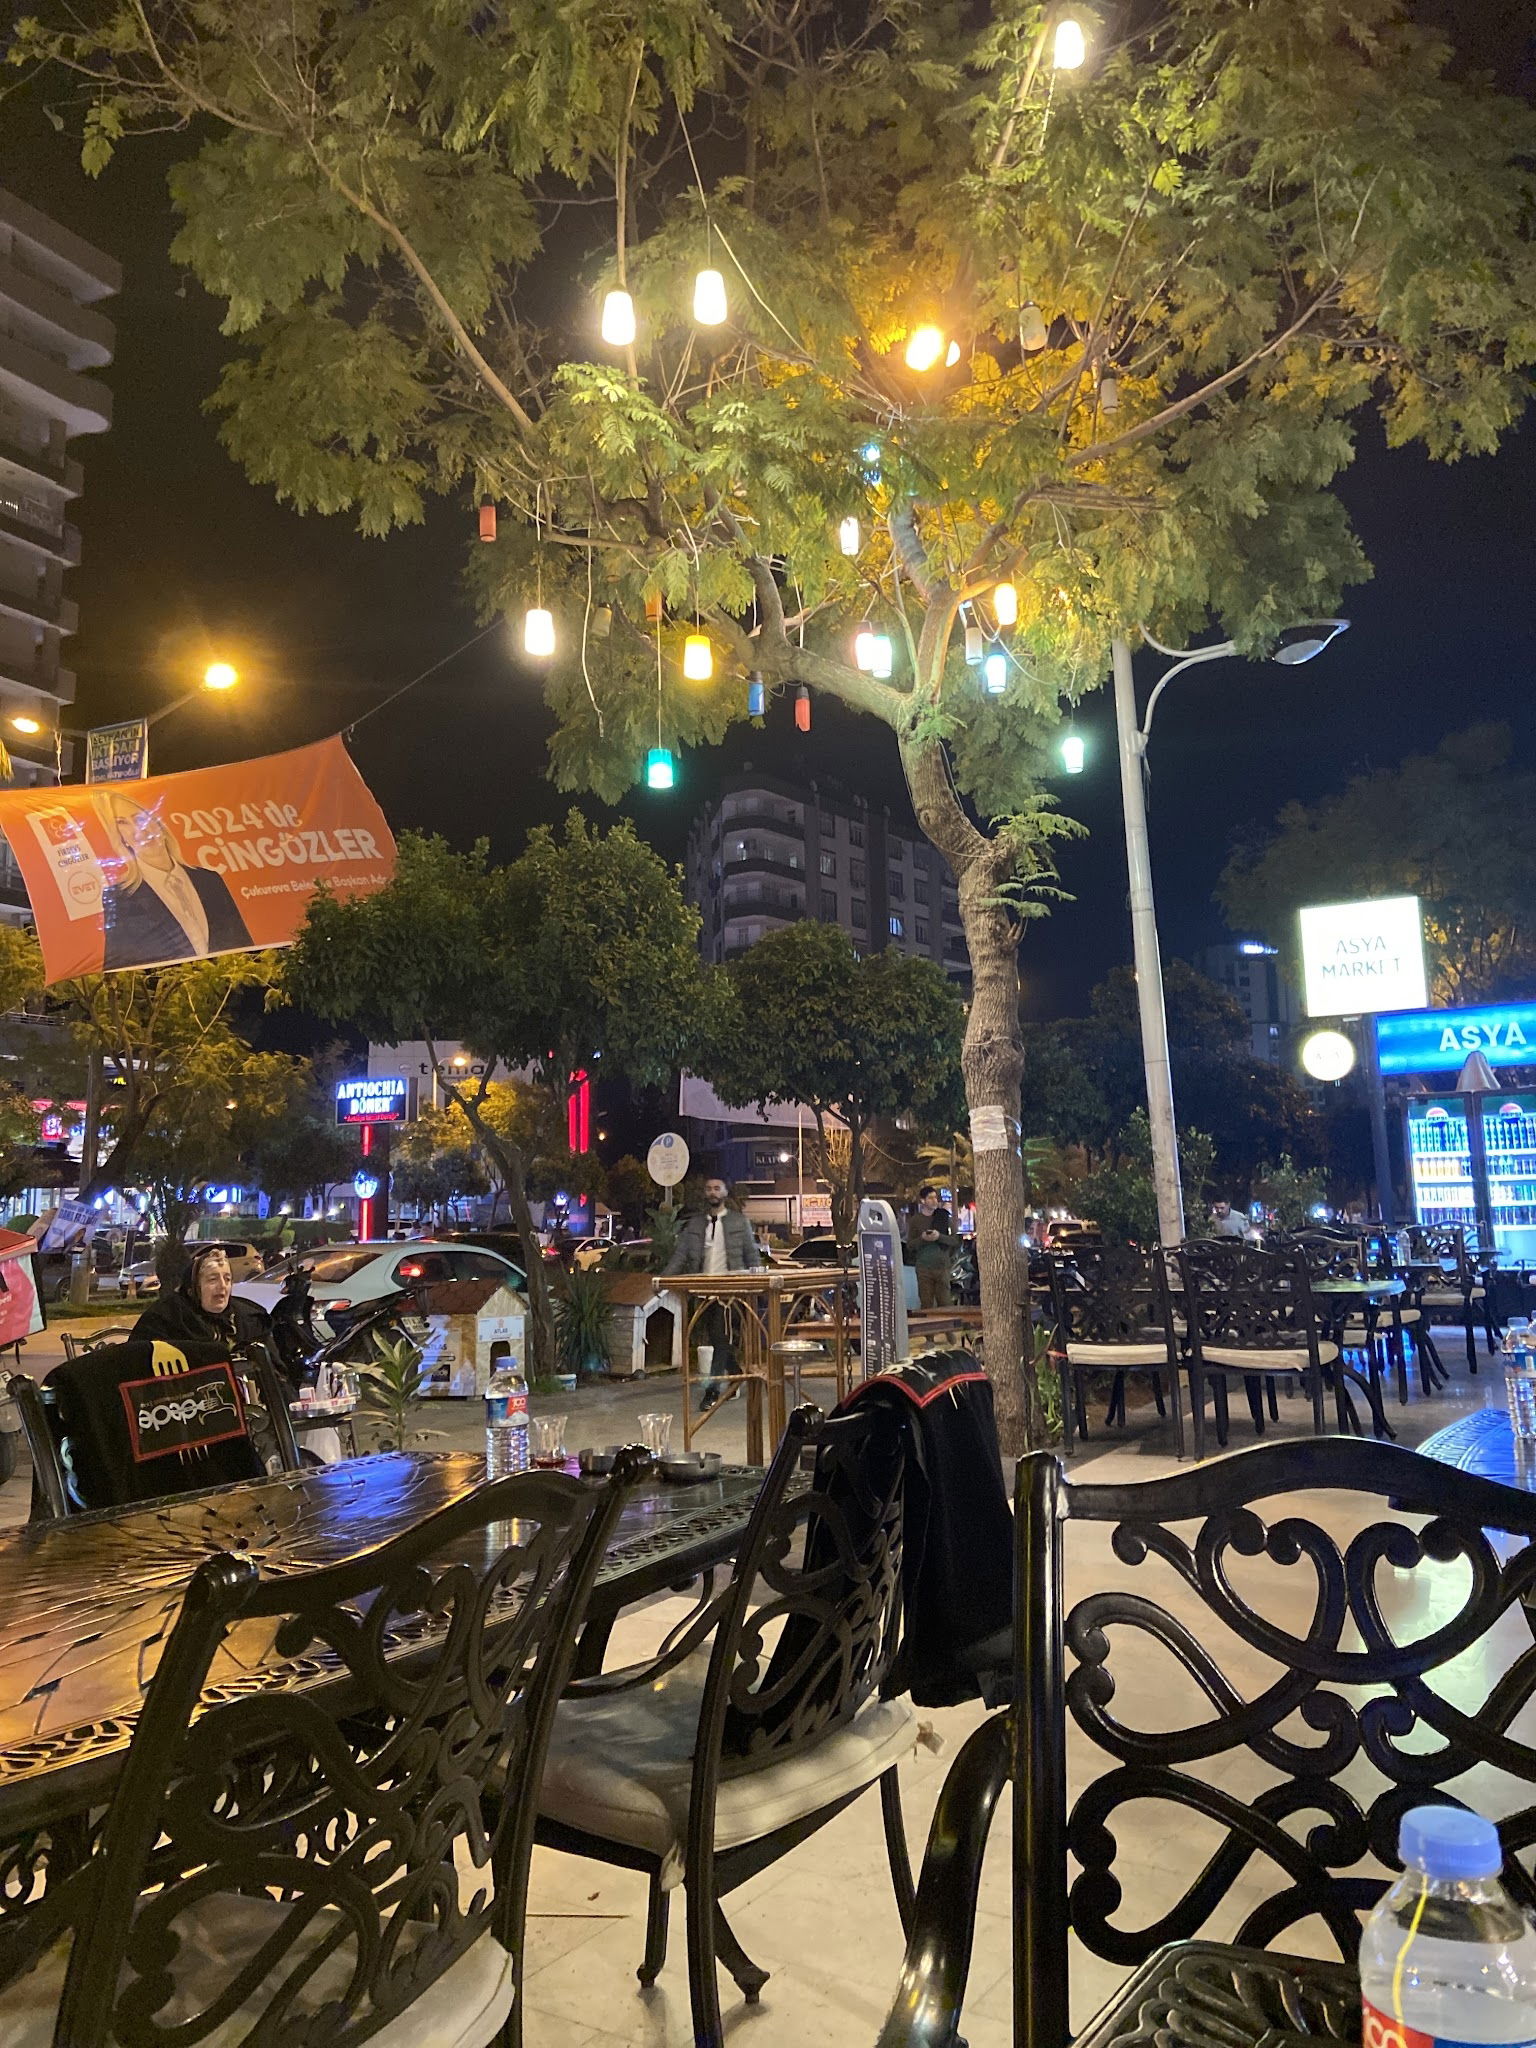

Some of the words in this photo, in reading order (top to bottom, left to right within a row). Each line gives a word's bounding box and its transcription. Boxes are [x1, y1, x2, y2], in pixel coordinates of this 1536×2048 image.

[171, 800, 303, 840] 2024'de
[240, 883, 291, 900] Çukurova
[1336, 935, 1387, 955] ASYA
[1439, 1021, 1527, 1052] ASYA
[418, 1062, 485, 1075] tema
[337, 1080, 405, 1100] ANTIOCHIA
